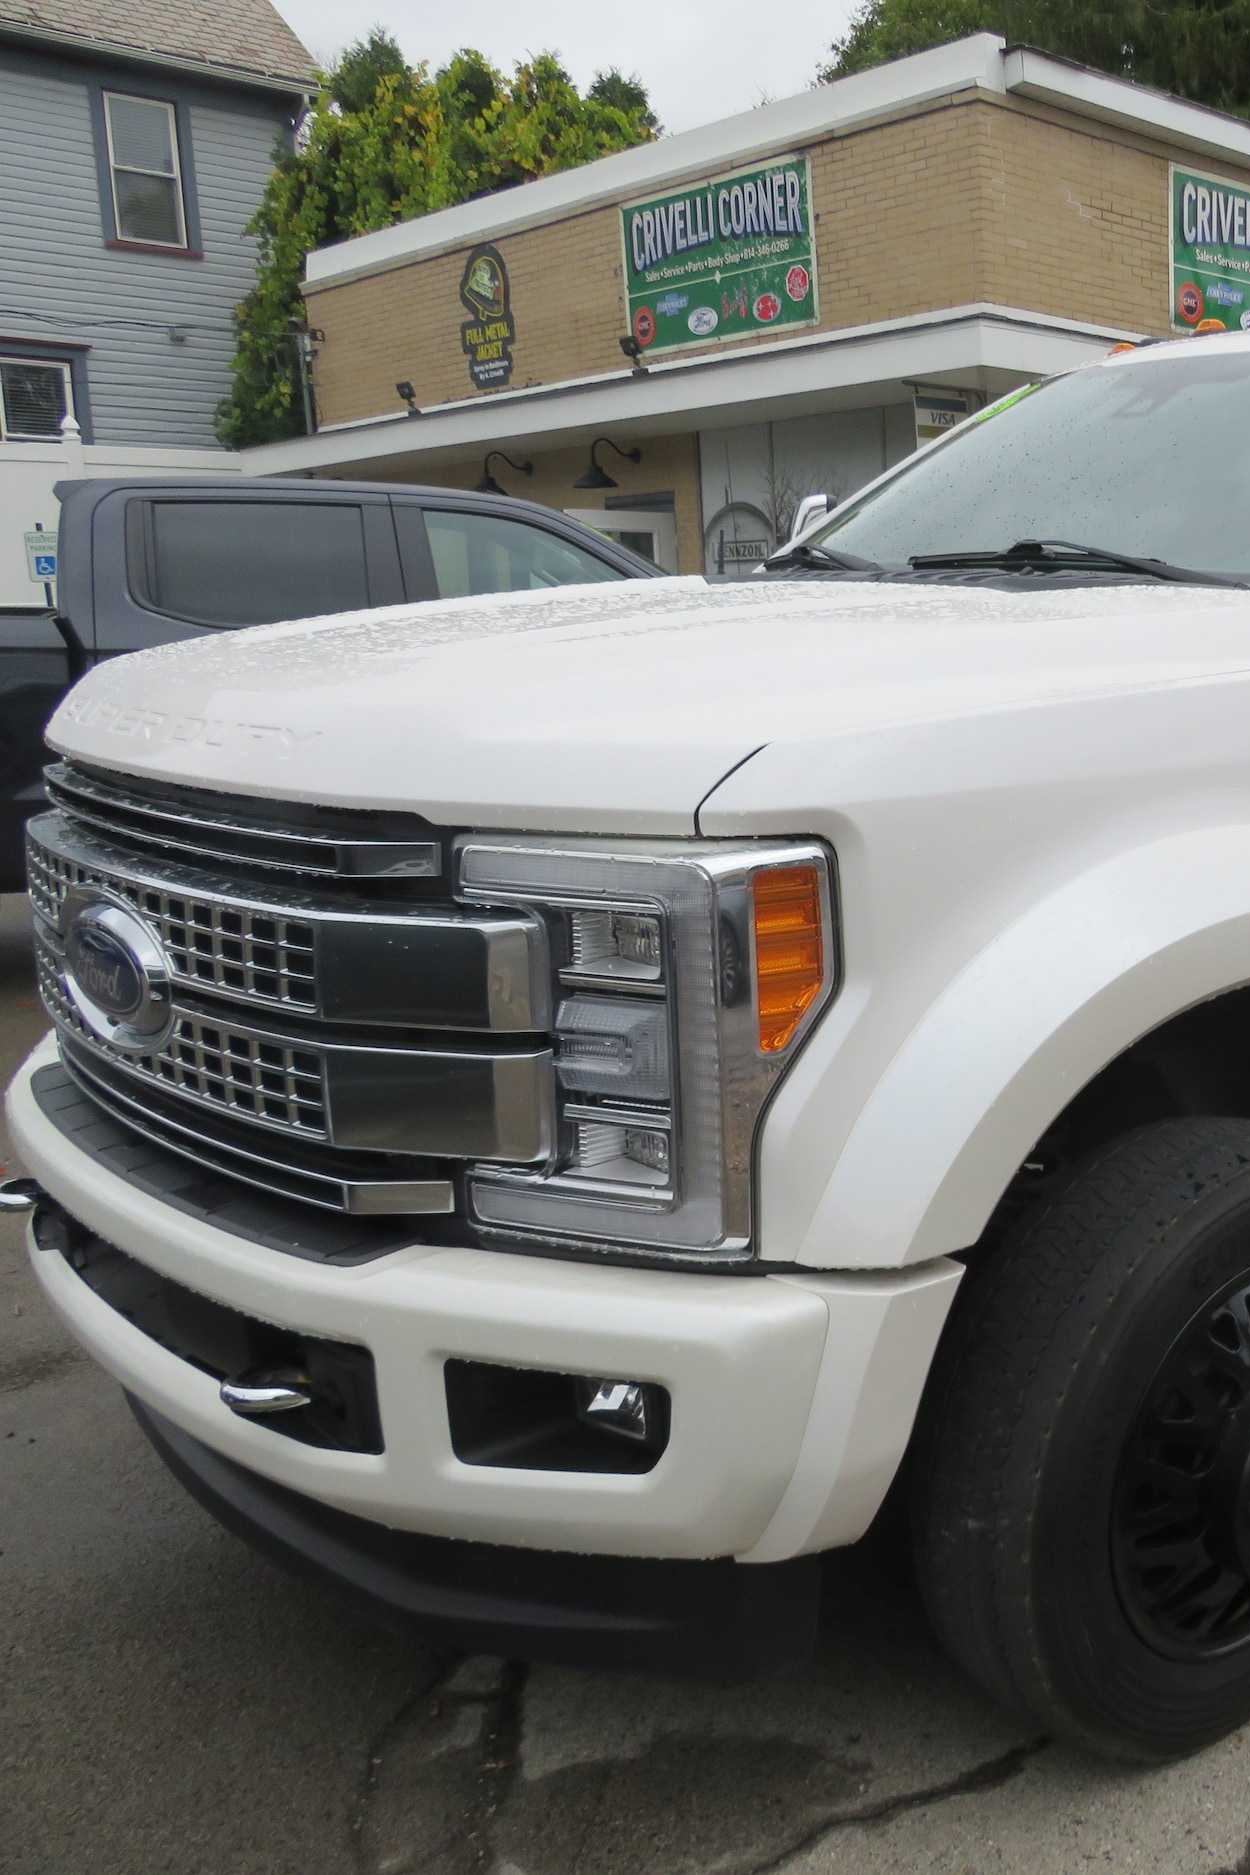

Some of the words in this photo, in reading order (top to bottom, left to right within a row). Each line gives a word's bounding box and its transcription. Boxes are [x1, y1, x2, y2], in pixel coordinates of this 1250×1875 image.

[632, 193, 715, 271] CRIVELLI
[718, 171, 803, 237] CORNER
[645, 271, 661, 283] Sales
[663, 265, 685, 280] Service
[688, 260, 705, 273] Parts
[707, 256, 724, 270] Body
[724, 253, 740, 266] Shop
[1195, 249, 1214, 264] Sales
[1217, 254, 1242, 271] Service
[1182, 297, 1197, 308] GMC
[1208, 286, 1243, 304] CHEVROLET
[465, 327, 485, 346] FULL
[485, 321, 511, 341] METAL
[475, 341, 503, 362] JACKET
[931, 412, 956, 426] VISA
[718, 544, 765, 558] ENNZOIL
[77, 938, 123, 1001] Ford
